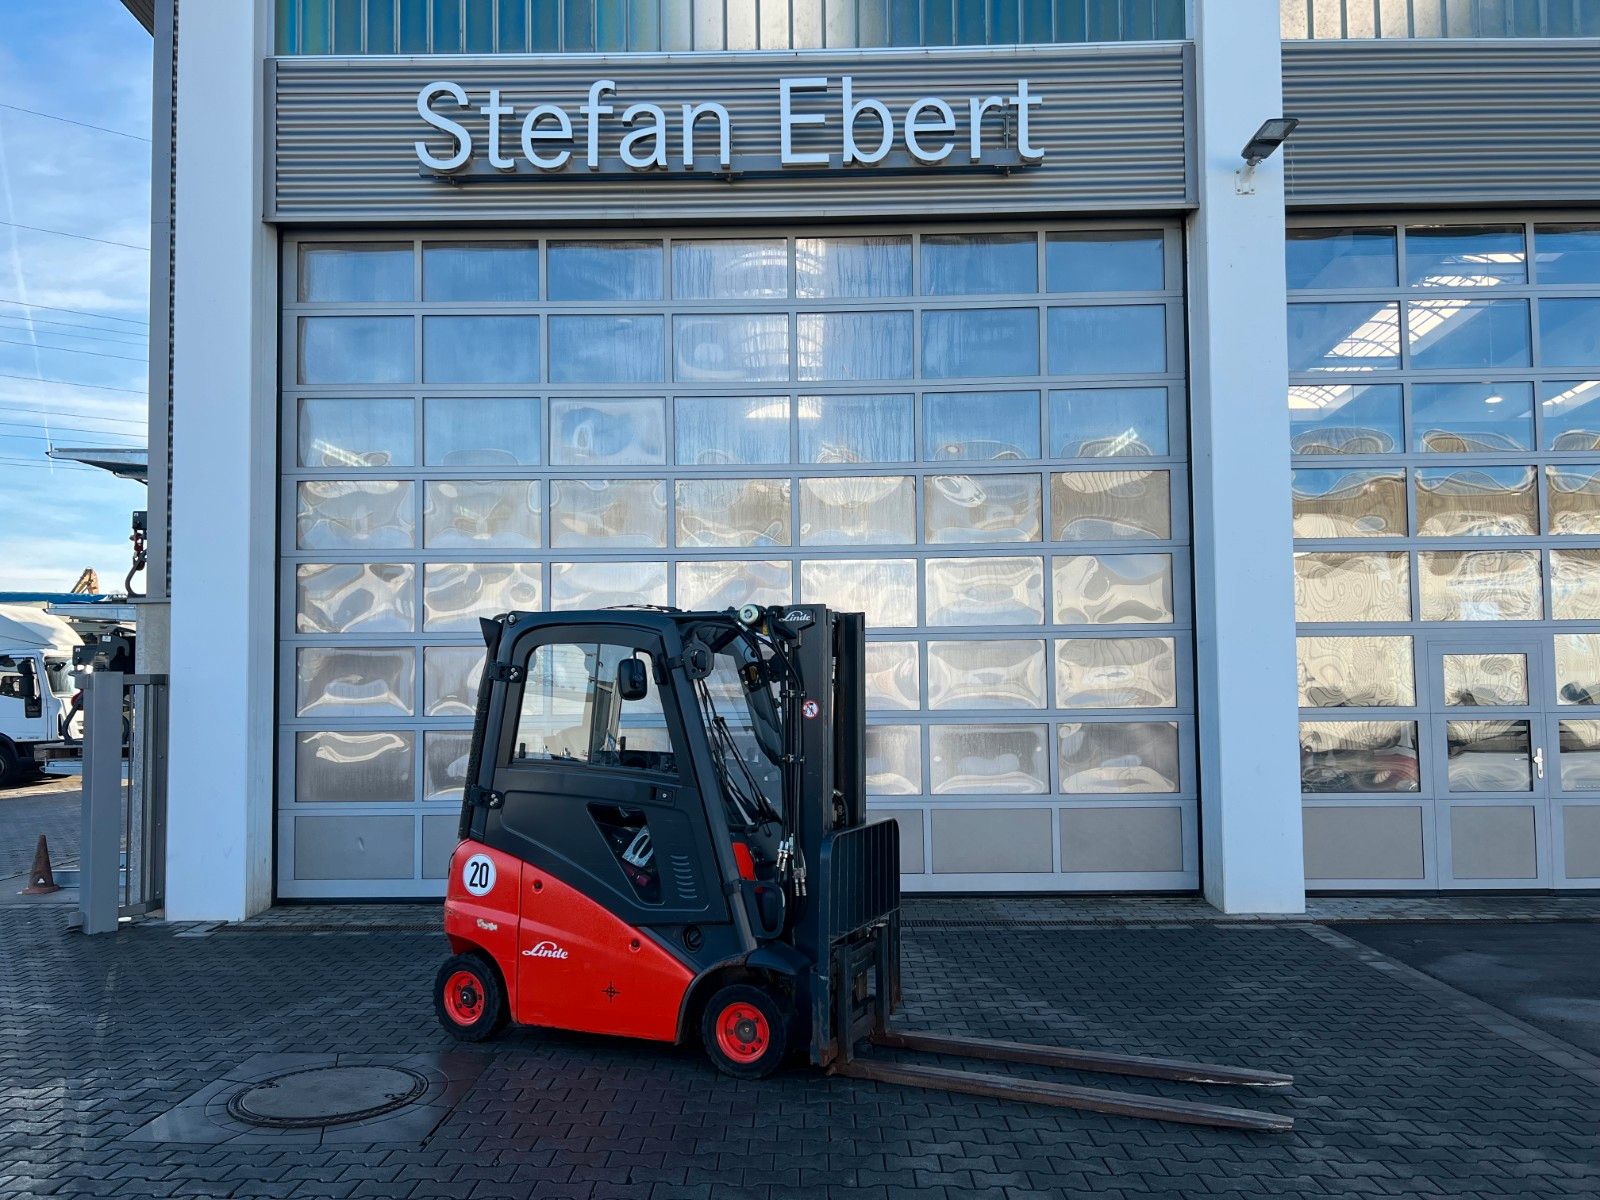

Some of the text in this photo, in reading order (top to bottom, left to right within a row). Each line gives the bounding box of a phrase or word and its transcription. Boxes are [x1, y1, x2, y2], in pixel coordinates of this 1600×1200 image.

[415, 76, 1045, 171] Stefan Ebert
[778, 610, 811, 622] Linde
[469, 861, 490, 889] 20
[521, 940, 569, 960] Linde
